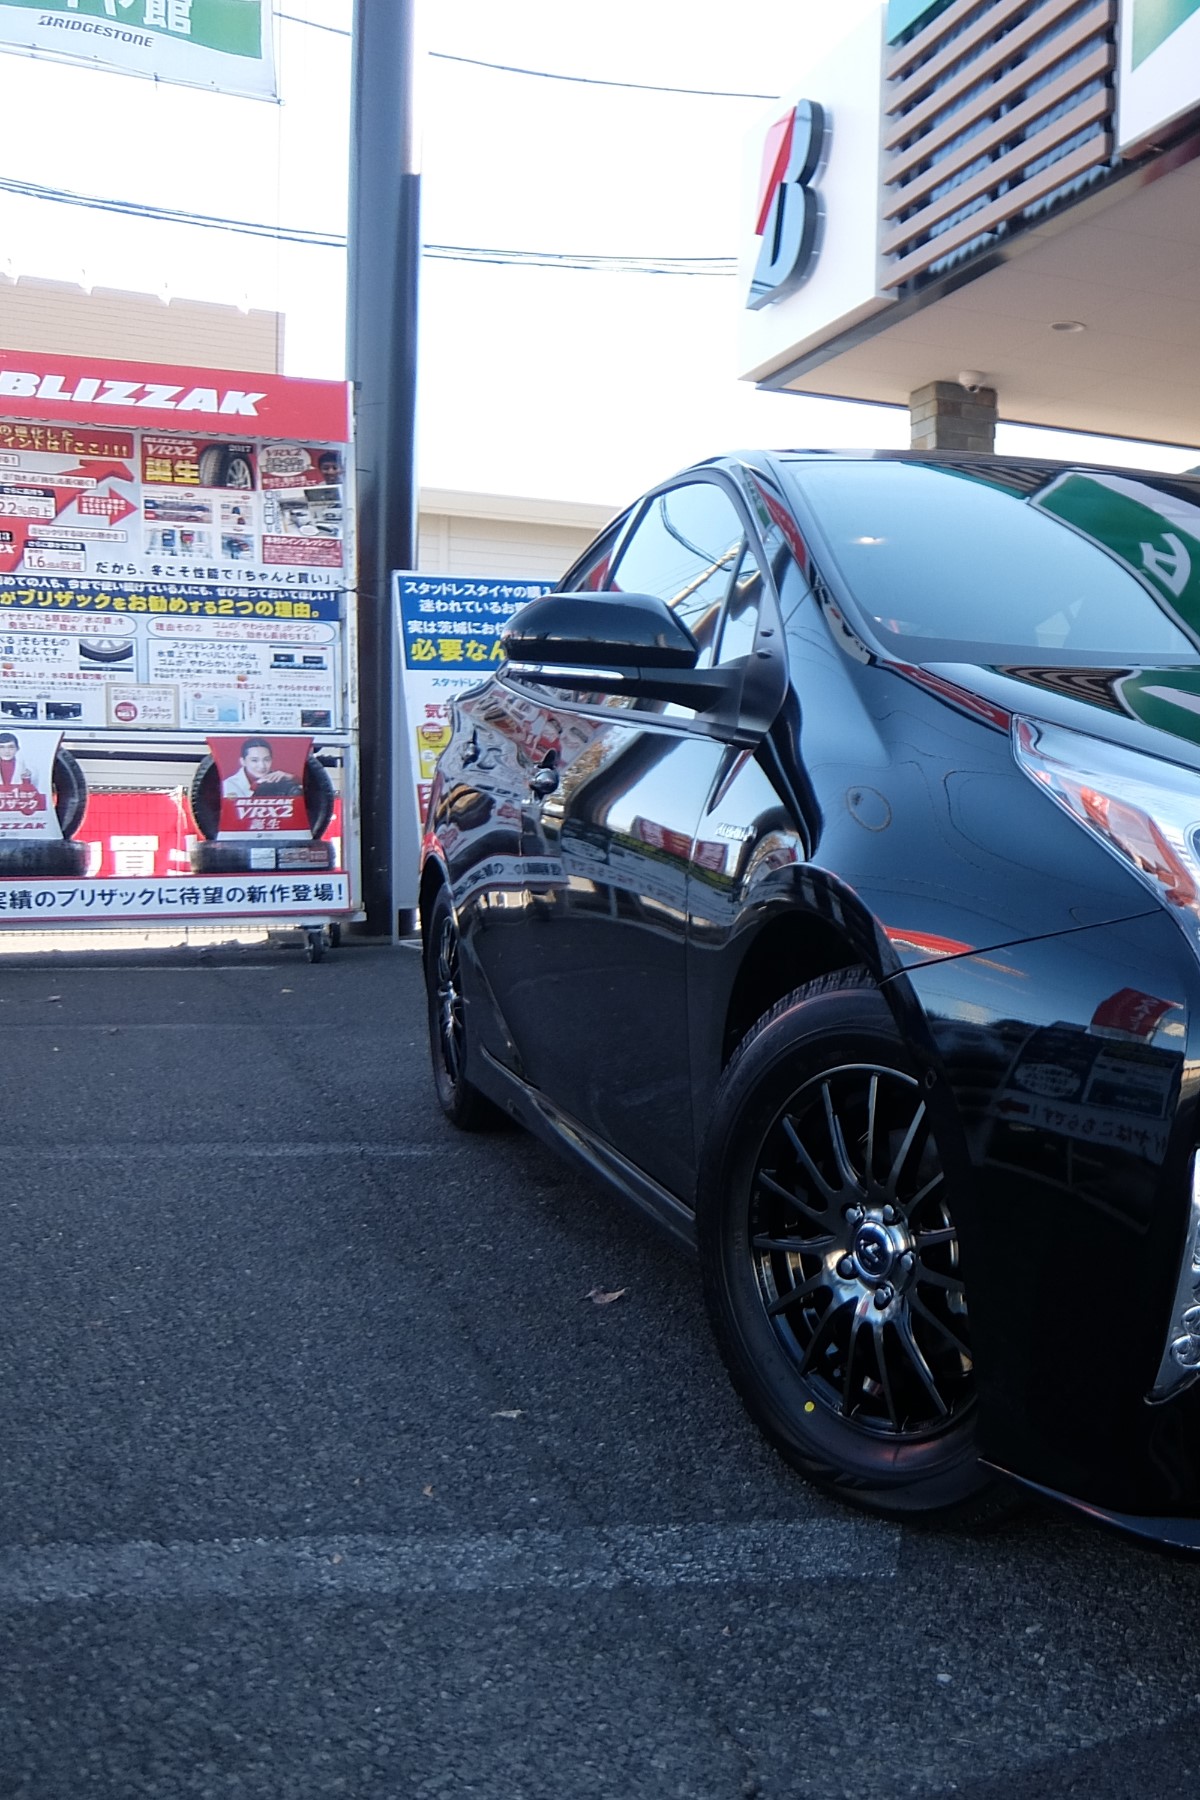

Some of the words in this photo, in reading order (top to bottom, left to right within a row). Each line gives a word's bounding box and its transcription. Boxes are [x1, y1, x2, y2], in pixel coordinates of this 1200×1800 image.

[38, 15, 154, 48] BRIDGESTONE
[0, 370, 268, 417] BLIZZAK
[146, 443, 199, 457] VRX2
[235, 798, 295, 807] BLIZZAK
[236, 805, 294, 819] VRX2
[251, 818, 280, 830] 誕生
